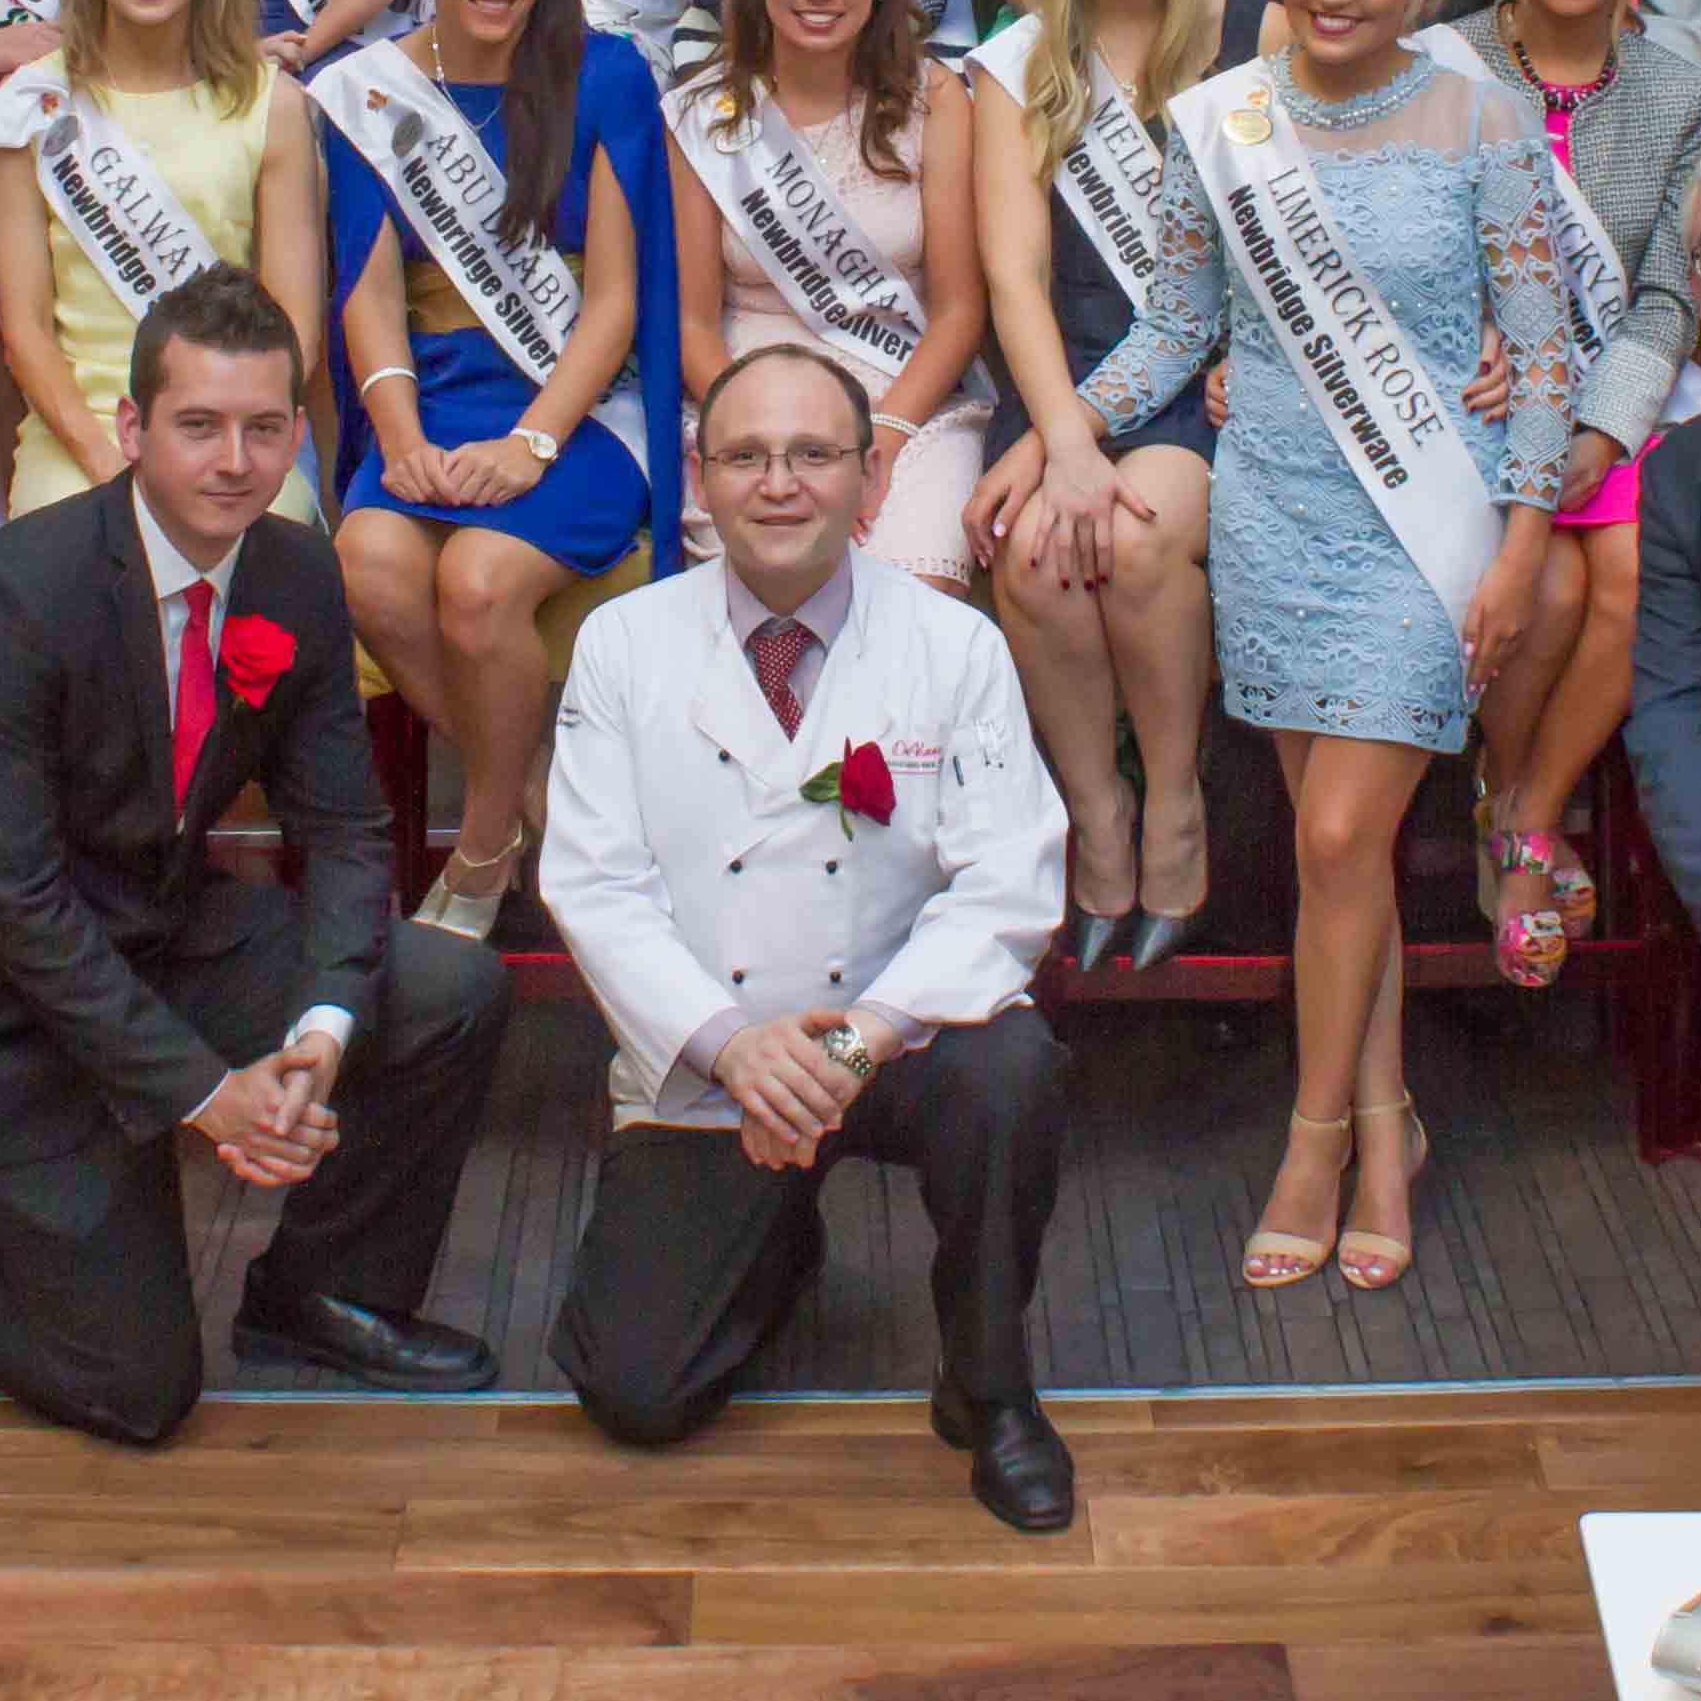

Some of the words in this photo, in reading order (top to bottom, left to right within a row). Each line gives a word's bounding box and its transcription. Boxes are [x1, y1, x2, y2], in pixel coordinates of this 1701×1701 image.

[52, 154, 158, 297] Newbridge
[402, 155, 503, 298] Newbridge
[427, 130, 495, 206] ABU
[740, 187, 848, 325] Newbridge
[1267, 166, 1381, 345] LIMERICK
[1365, 343, 1445, 449] ROSE
[1227, 184, 1315, 337] Newbridge
[1303, 332, 1410, 491] Silverware
